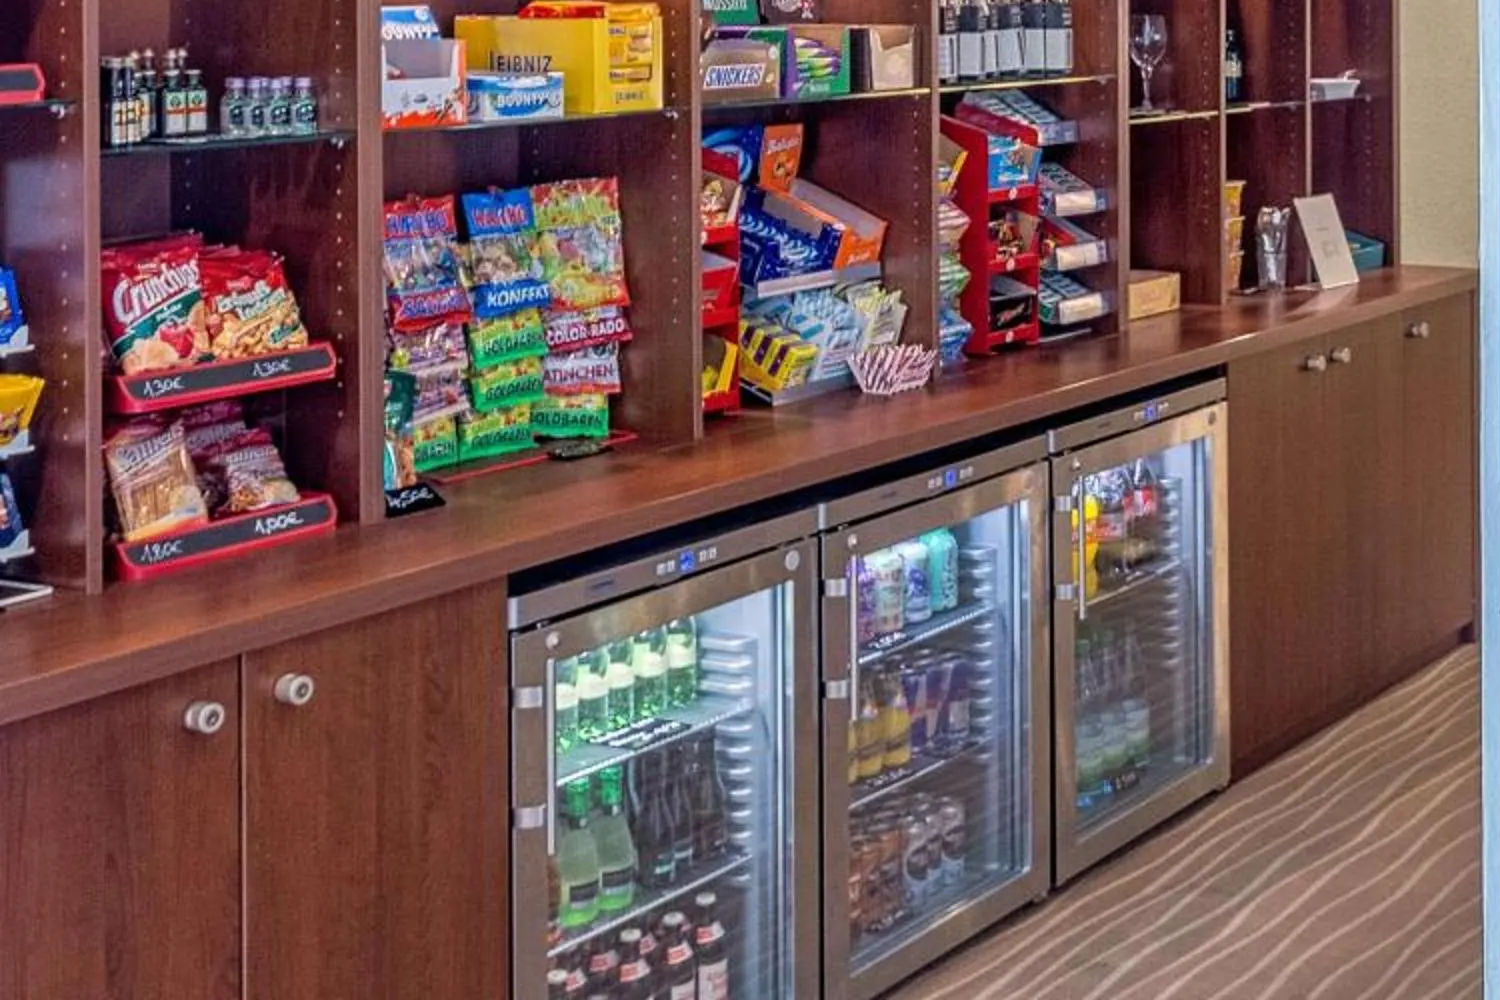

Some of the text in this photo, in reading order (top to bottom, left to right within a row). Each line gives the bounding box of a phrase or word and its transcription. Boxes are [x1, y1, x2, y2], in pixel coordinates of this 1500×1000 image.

[382, 23, 438, 41] OUNTY
[705, 65, 764, 87] SNICKERS
[112, 259, 201, 324] Crunchips
[487, 284, 550, 307] KONFEKT
[544, 364, 614, 382] ATINCHEN
